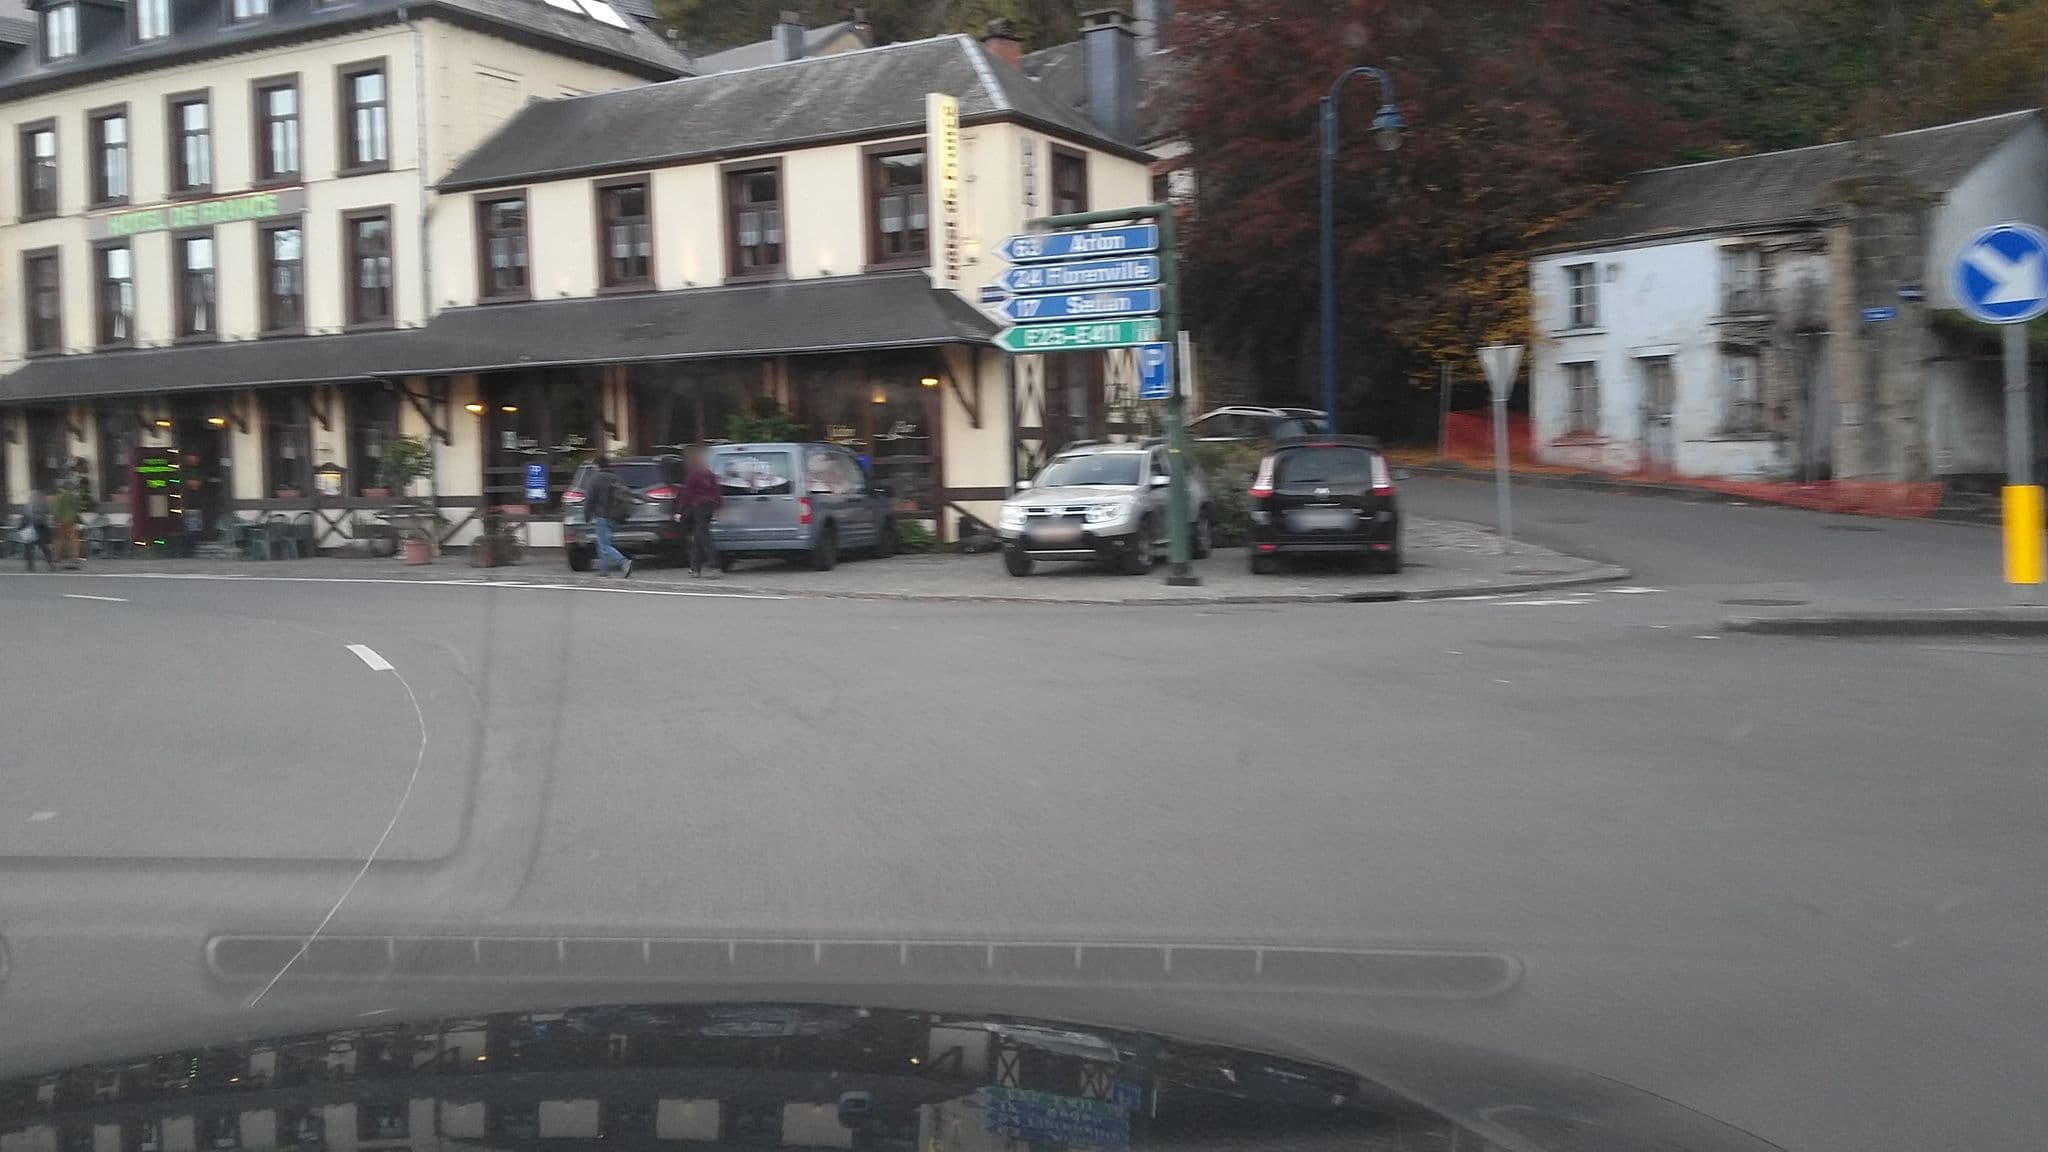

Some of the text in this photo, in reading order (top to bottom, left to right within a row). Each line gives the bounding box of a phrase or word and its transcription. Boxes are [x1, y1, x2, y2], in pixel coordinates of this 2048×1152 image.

[1071, 234, 1126, 253] Arlon
[1013, 262, 1150, 288] 24 Florenville
[1016, 295, 1132, 317] 17 Sedan
